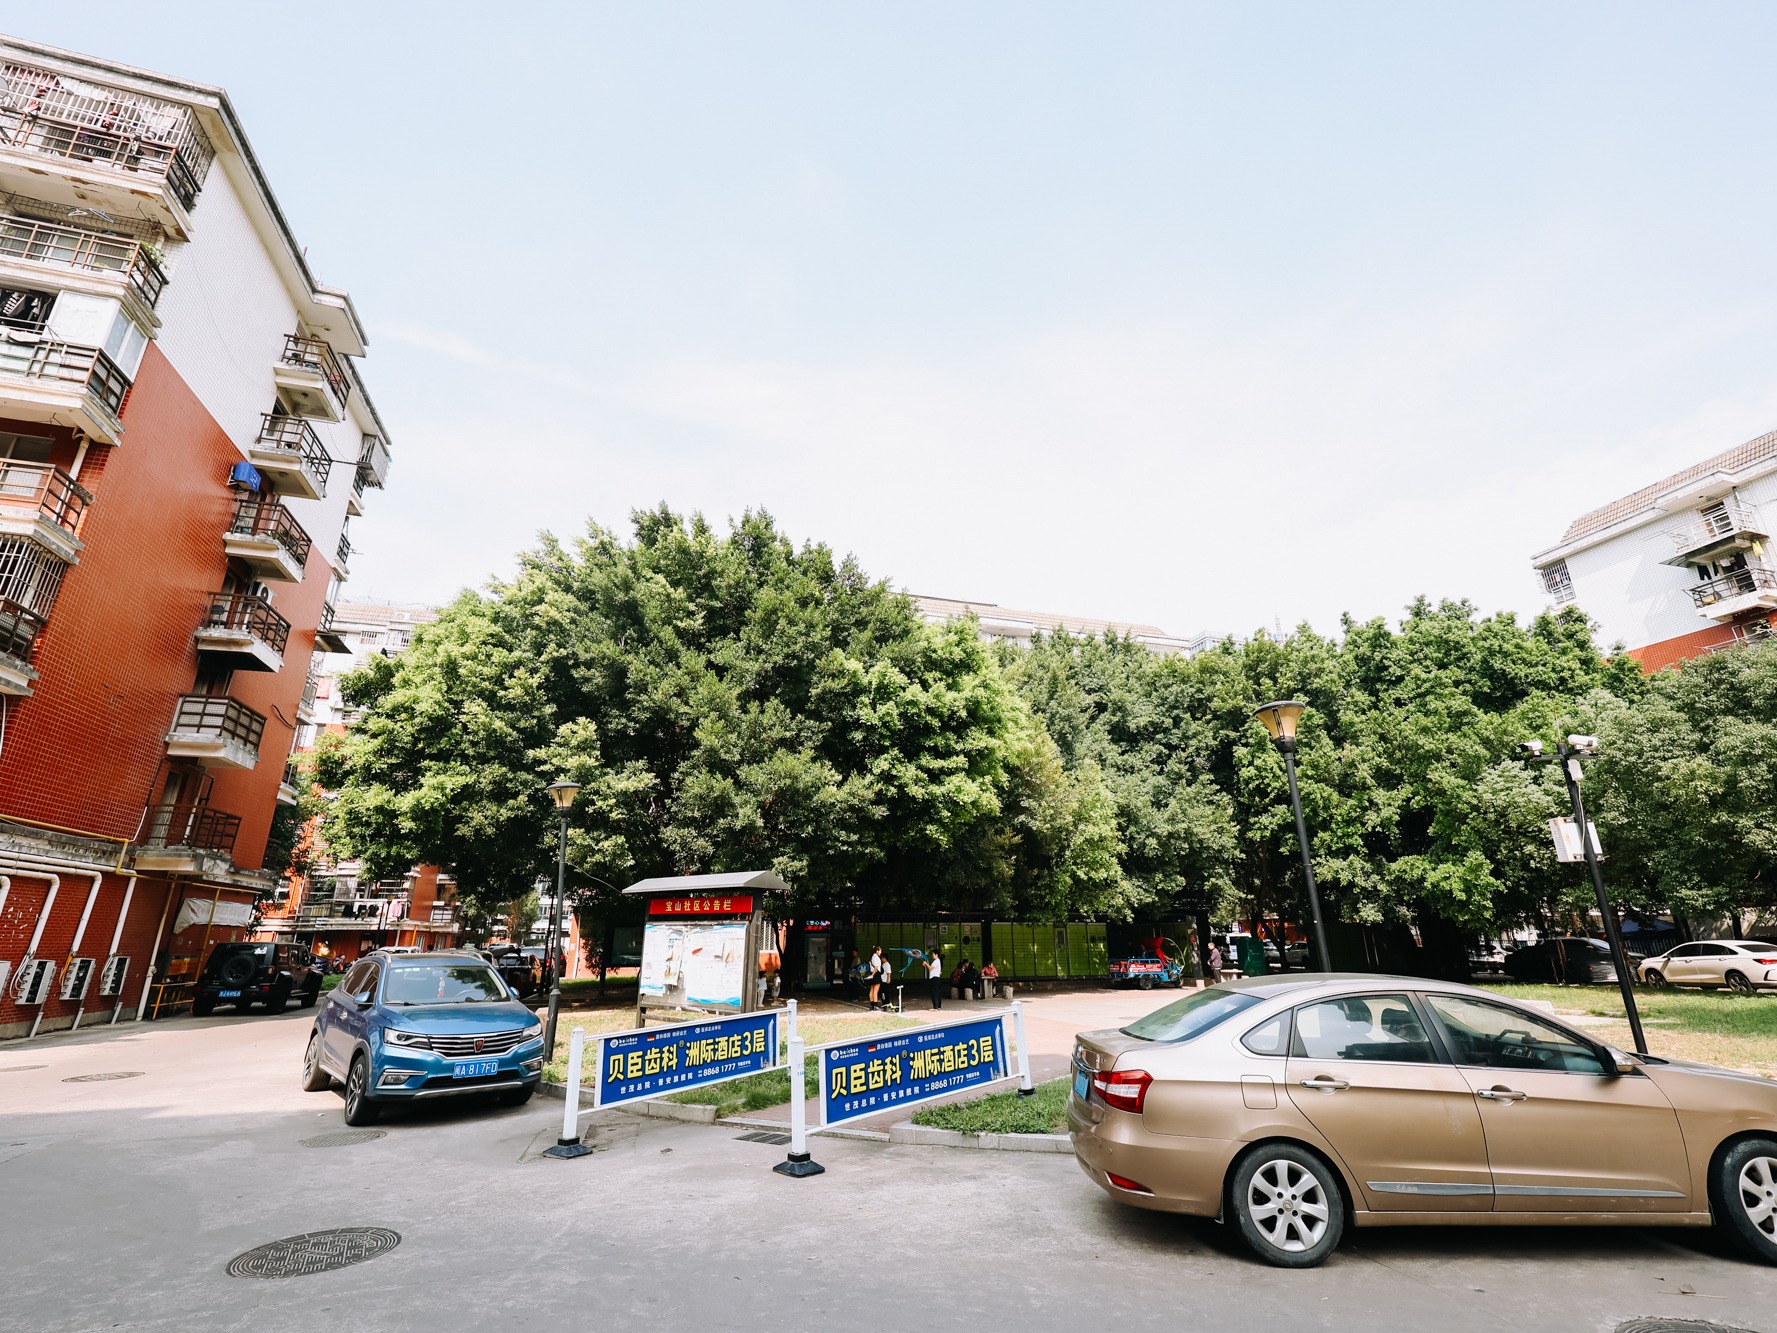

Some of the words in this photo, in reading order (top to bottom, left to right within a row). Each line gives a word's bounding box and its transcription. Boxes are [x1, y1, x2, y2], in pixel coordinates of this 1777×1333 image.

[665, 899, 732, 912] 宝山社区公告栏
[607, 1043, 678, 1083] 贝臣齿科
[685, 1029, 766, 1068] 洲际酒店3层
[703, 1066, 720, 1077] 8868
[721, 1063, 736, 1073] 1777
[831, 1054, 902, 1099] 贝臣齿科
[909, 1035, 994, 1080] 洲际酒店3层
[930, 1079, 948, 1091] 8868
[949, 1075, 964, 1086] 1777
